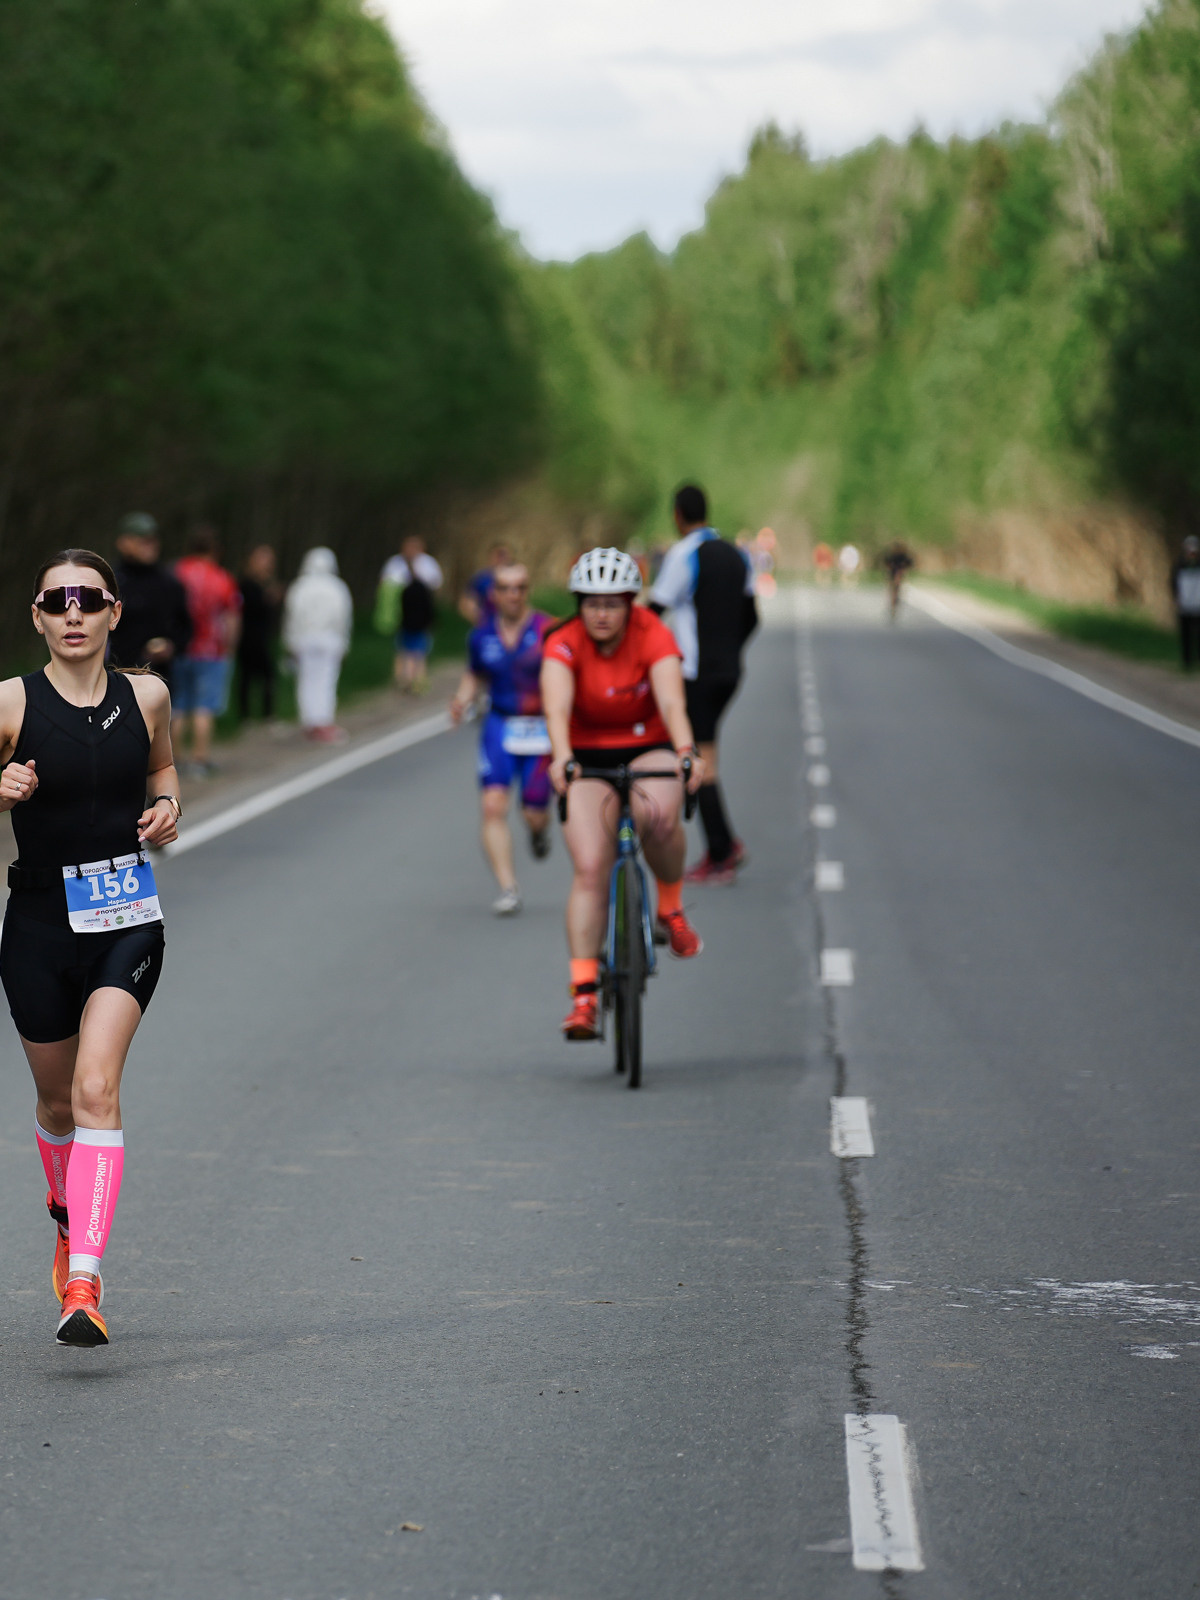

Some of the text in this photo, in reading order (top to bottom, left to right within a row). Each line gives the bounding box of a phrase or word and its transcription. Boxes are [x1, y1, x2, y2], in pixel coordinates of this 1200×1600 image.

[102, 705, 120, 730] 2XU
[87, 868, 140, 901] 156
[132, 955, 150, 983] 2XU
[89, 1154, 107, 1230] COMPRESSPRINT
